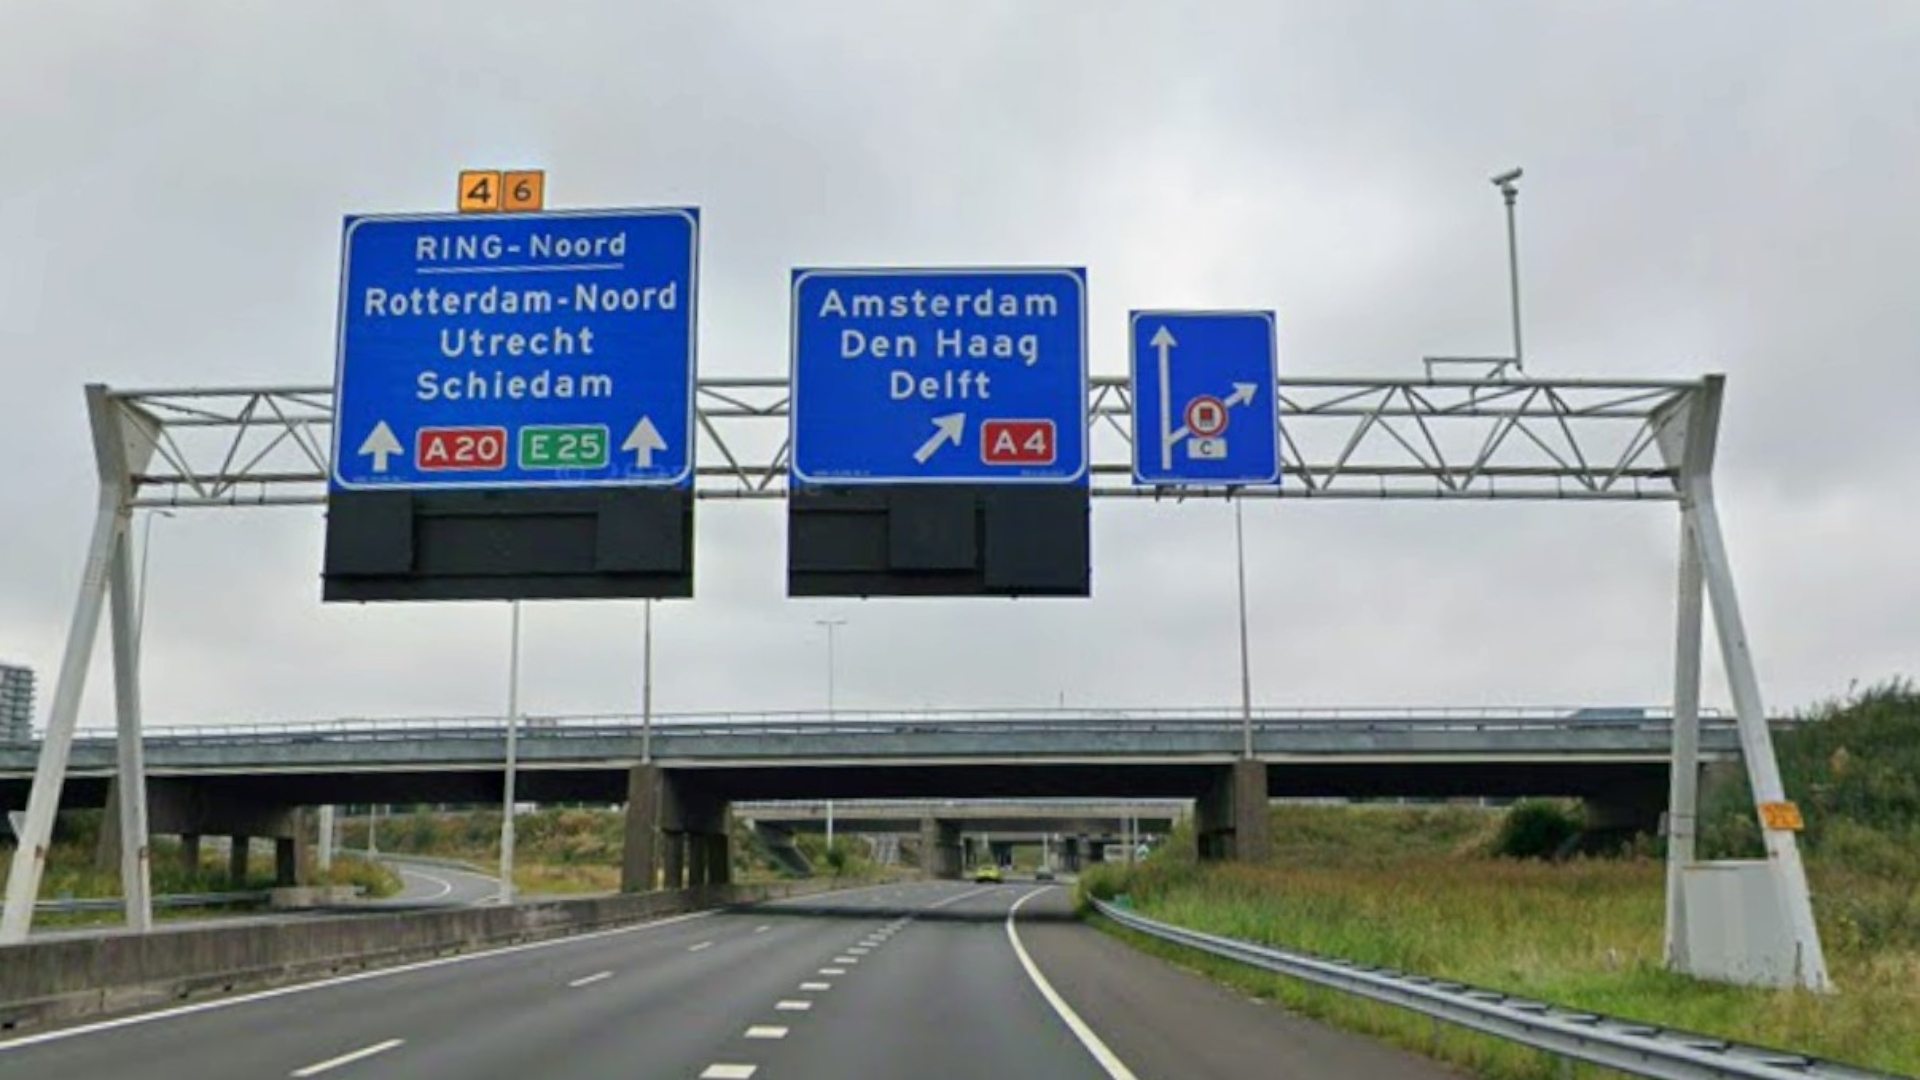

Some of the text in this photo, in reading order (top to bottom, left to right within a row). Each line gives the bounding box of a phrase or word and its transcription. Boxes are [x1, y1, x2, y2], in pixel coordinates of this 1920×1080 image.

[467, 178, 491, 203] 4
[513, 179, 531, 203] 6
[364, 281, 677, 316] Rotterdam-Noord
[820, 289, 1058, 317] Amsterdam
[440, 327, 594, 358] Utrecht
[841, 329, 1039, 367] Den Haag
[416, 370, 613, 400] Schiedam
[890, 370, 991, 400] Delft
[1199, 440, 1212, 455] C
